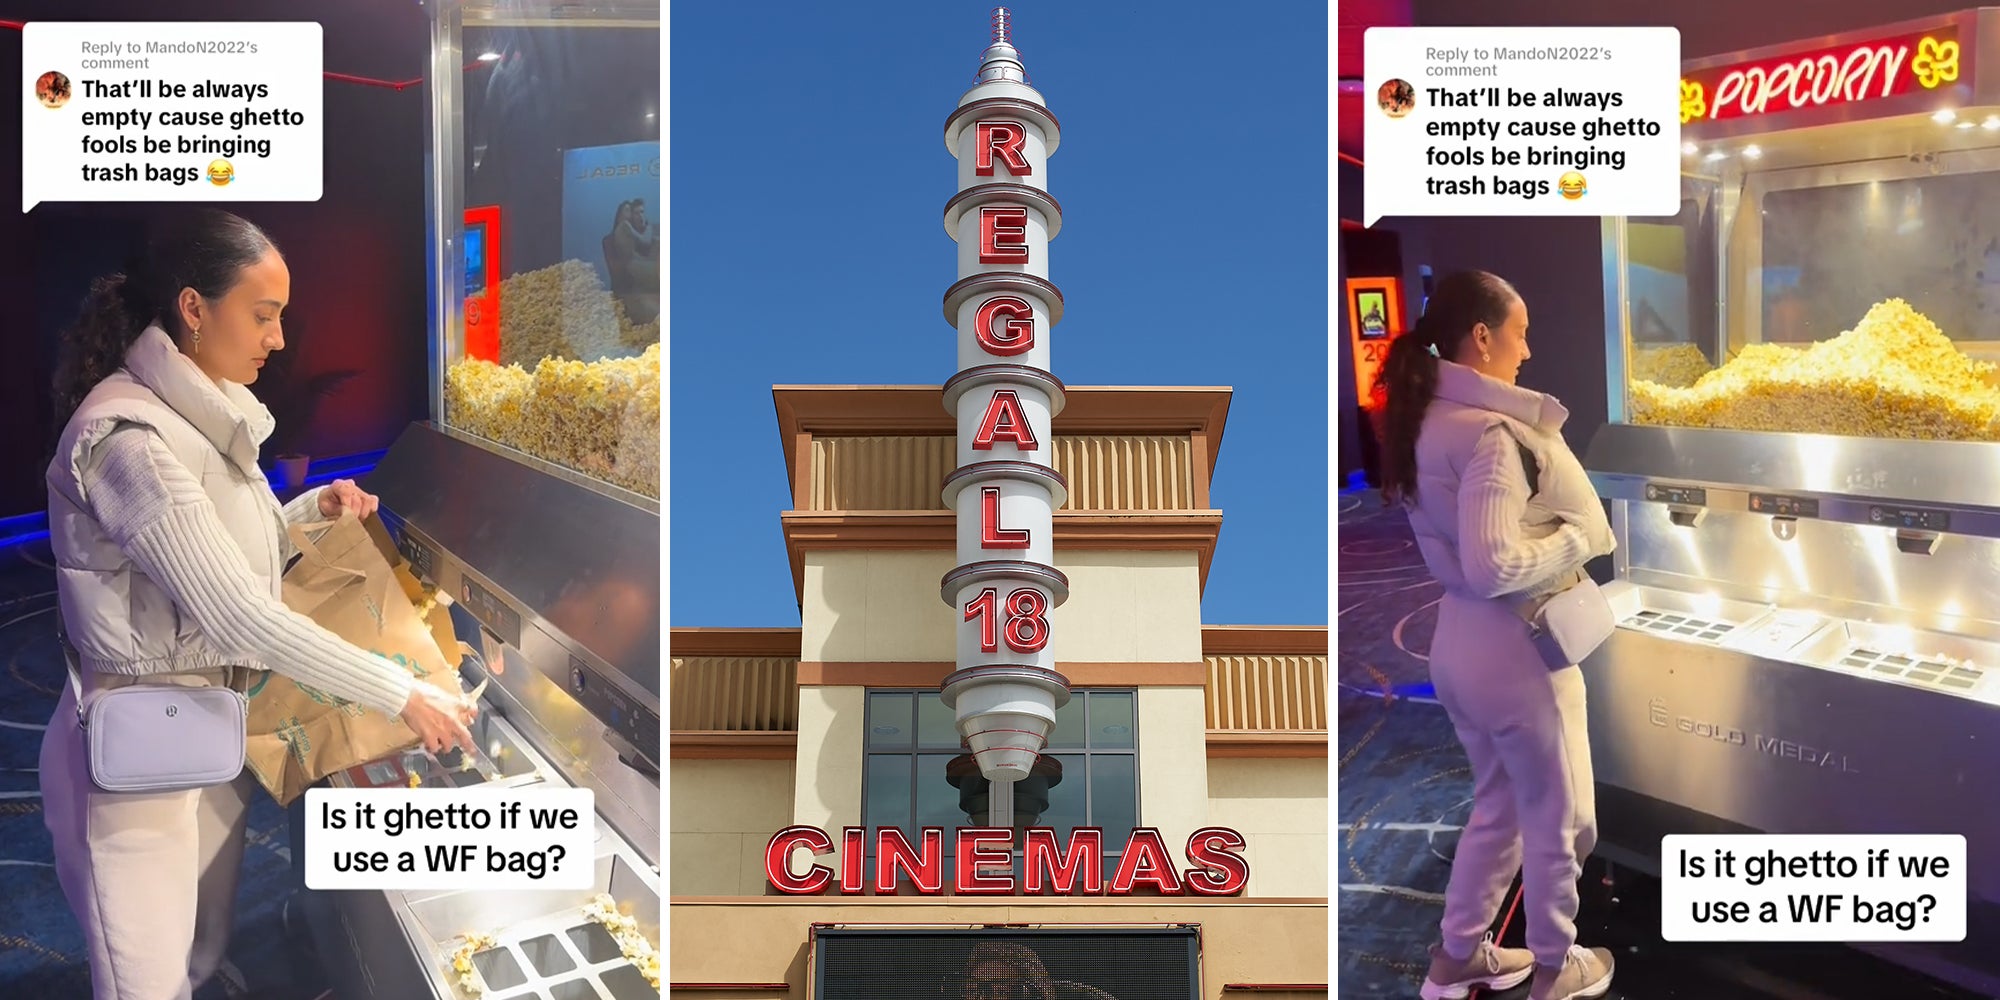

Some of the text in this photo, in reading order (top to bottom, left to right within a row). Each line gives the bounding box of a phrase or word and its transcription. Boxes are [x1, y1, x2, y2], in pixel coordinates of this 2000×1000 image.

[1710, 44, 1907, 119] POPCORN
[964, 587, 1050, 654] 18
[1676, 716, 1860, 774] GOLD MEDAL
[764, 823, 1251, 896] CINEMAS
